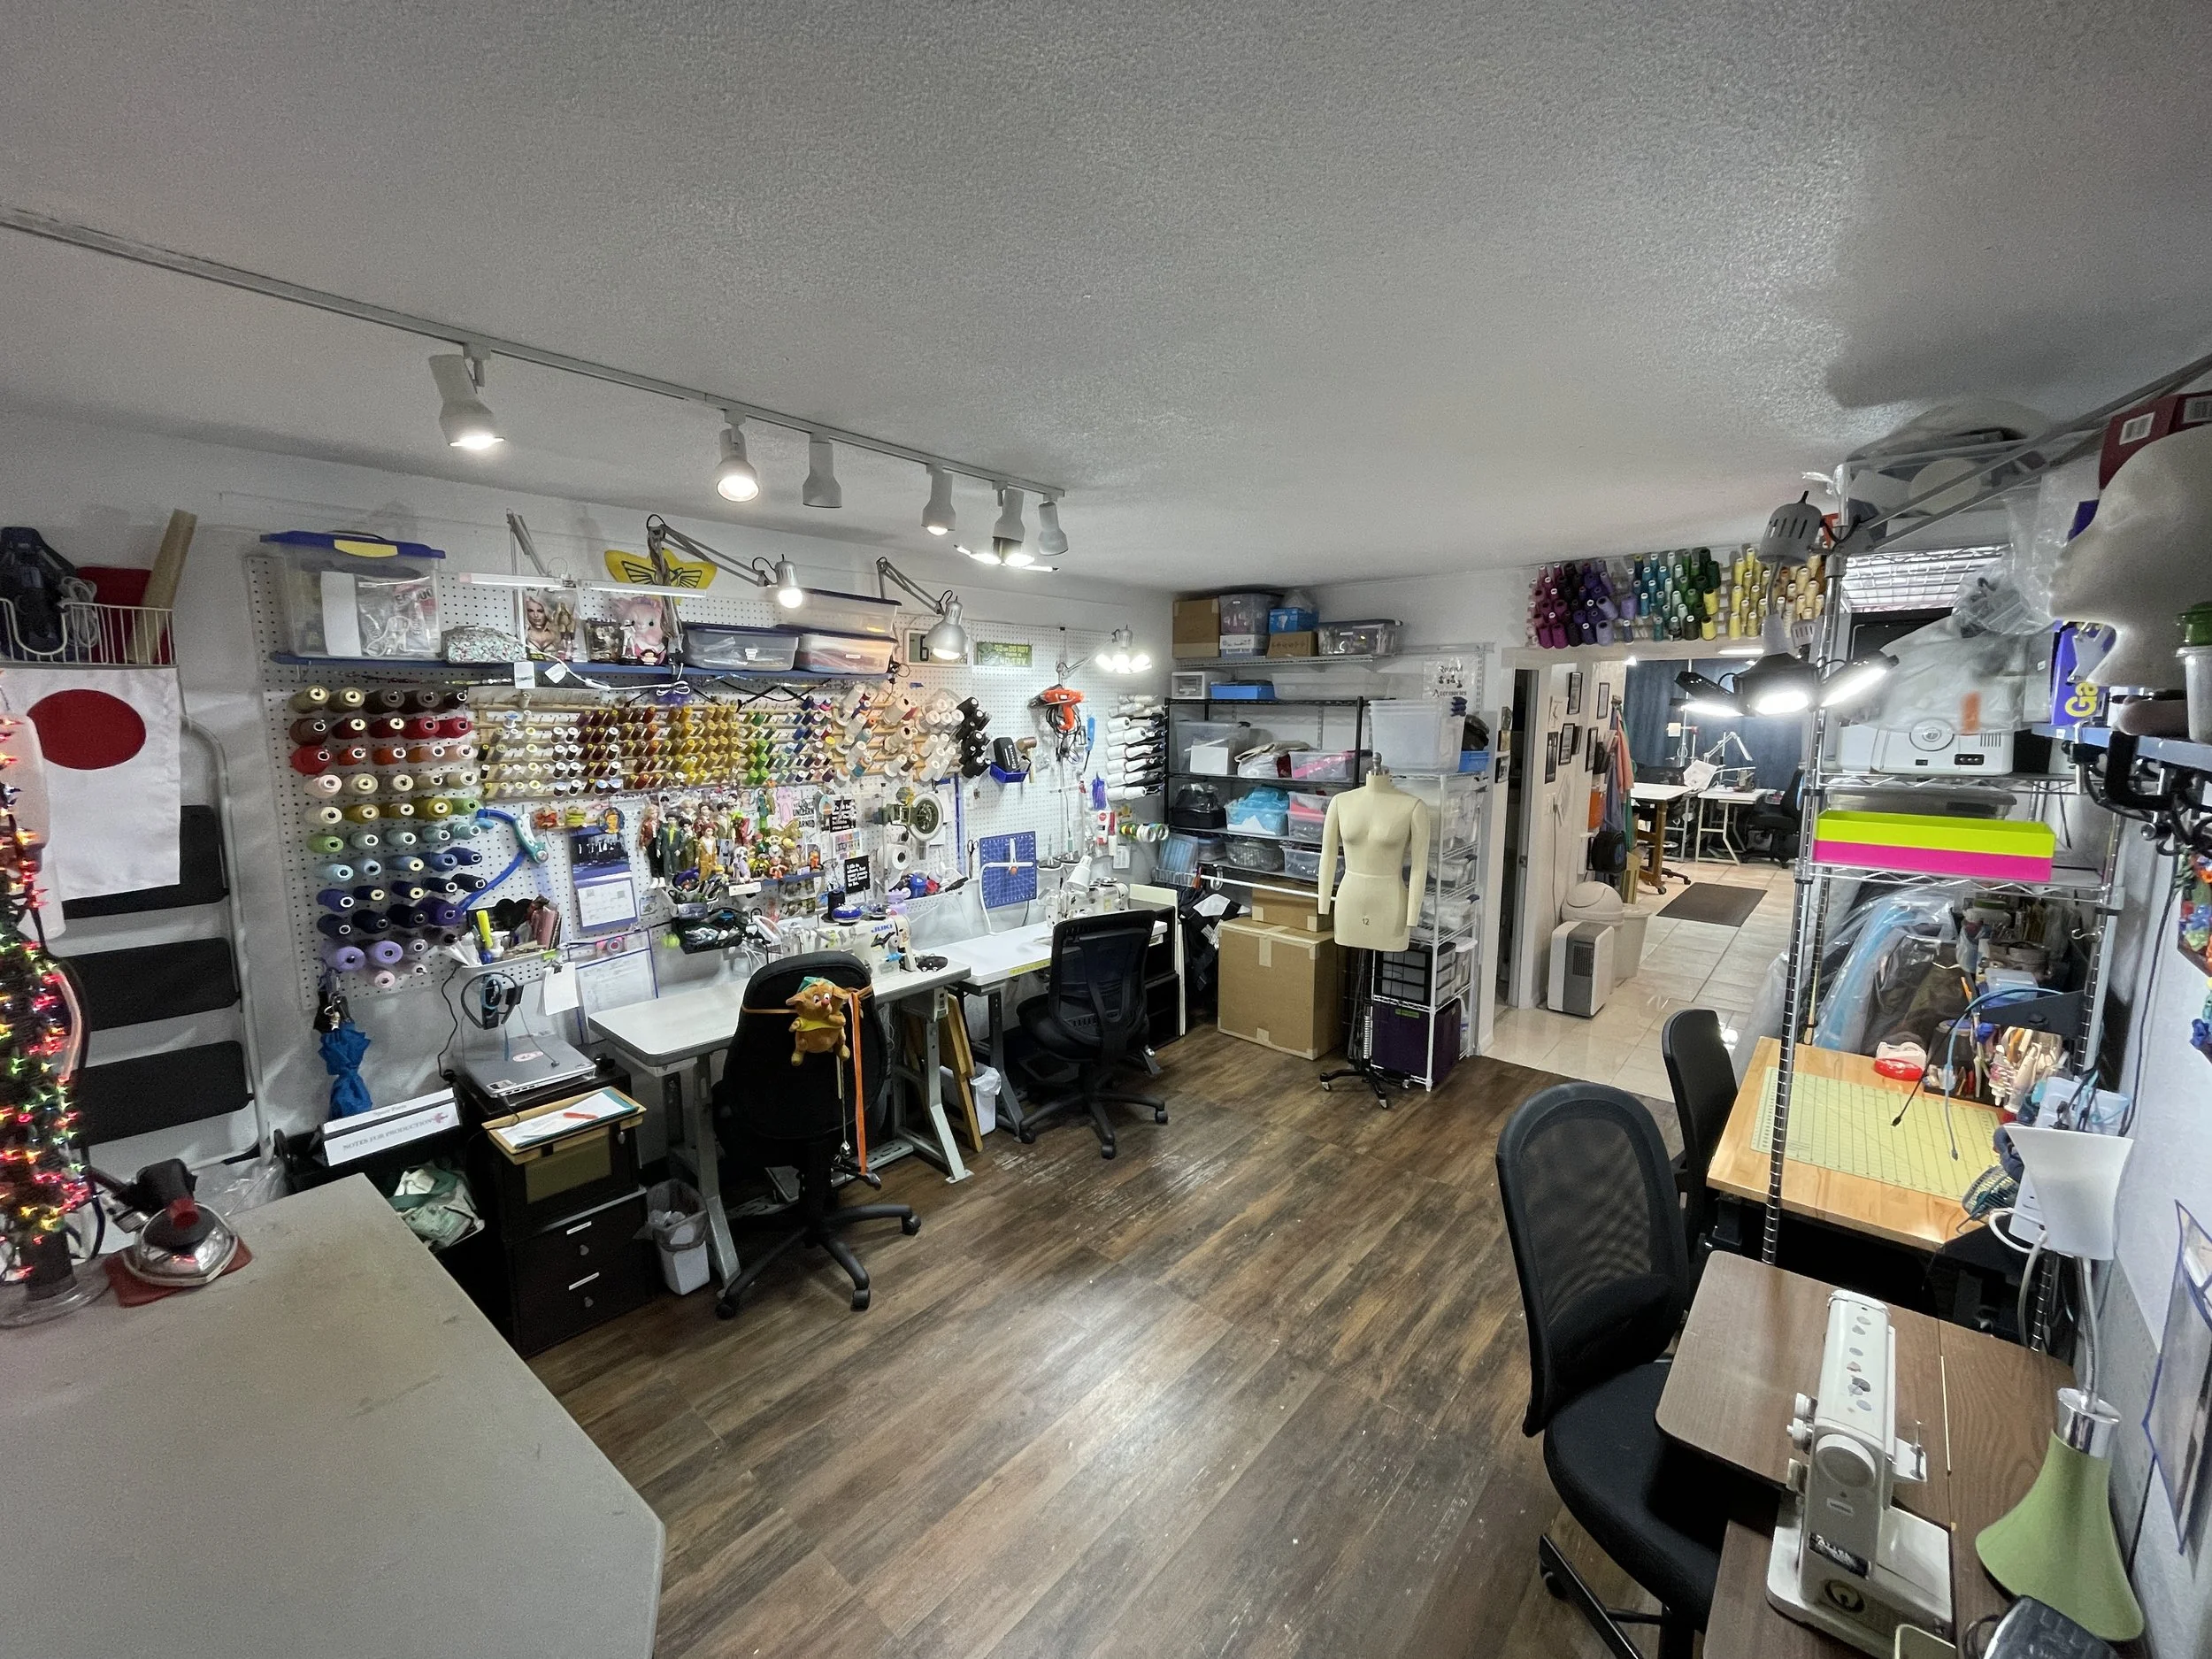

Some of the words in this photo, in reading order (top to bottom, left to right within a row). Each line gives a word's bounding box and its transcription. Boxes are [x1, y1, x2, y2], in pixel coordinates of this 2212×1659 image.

[871, 924, 893, 933] JUKI
[342, 1139, 369, 1150] NOTES
[370, 1133, 385, 1142] FOR
[386, 1118, 434, 1137] PRODUCTION
